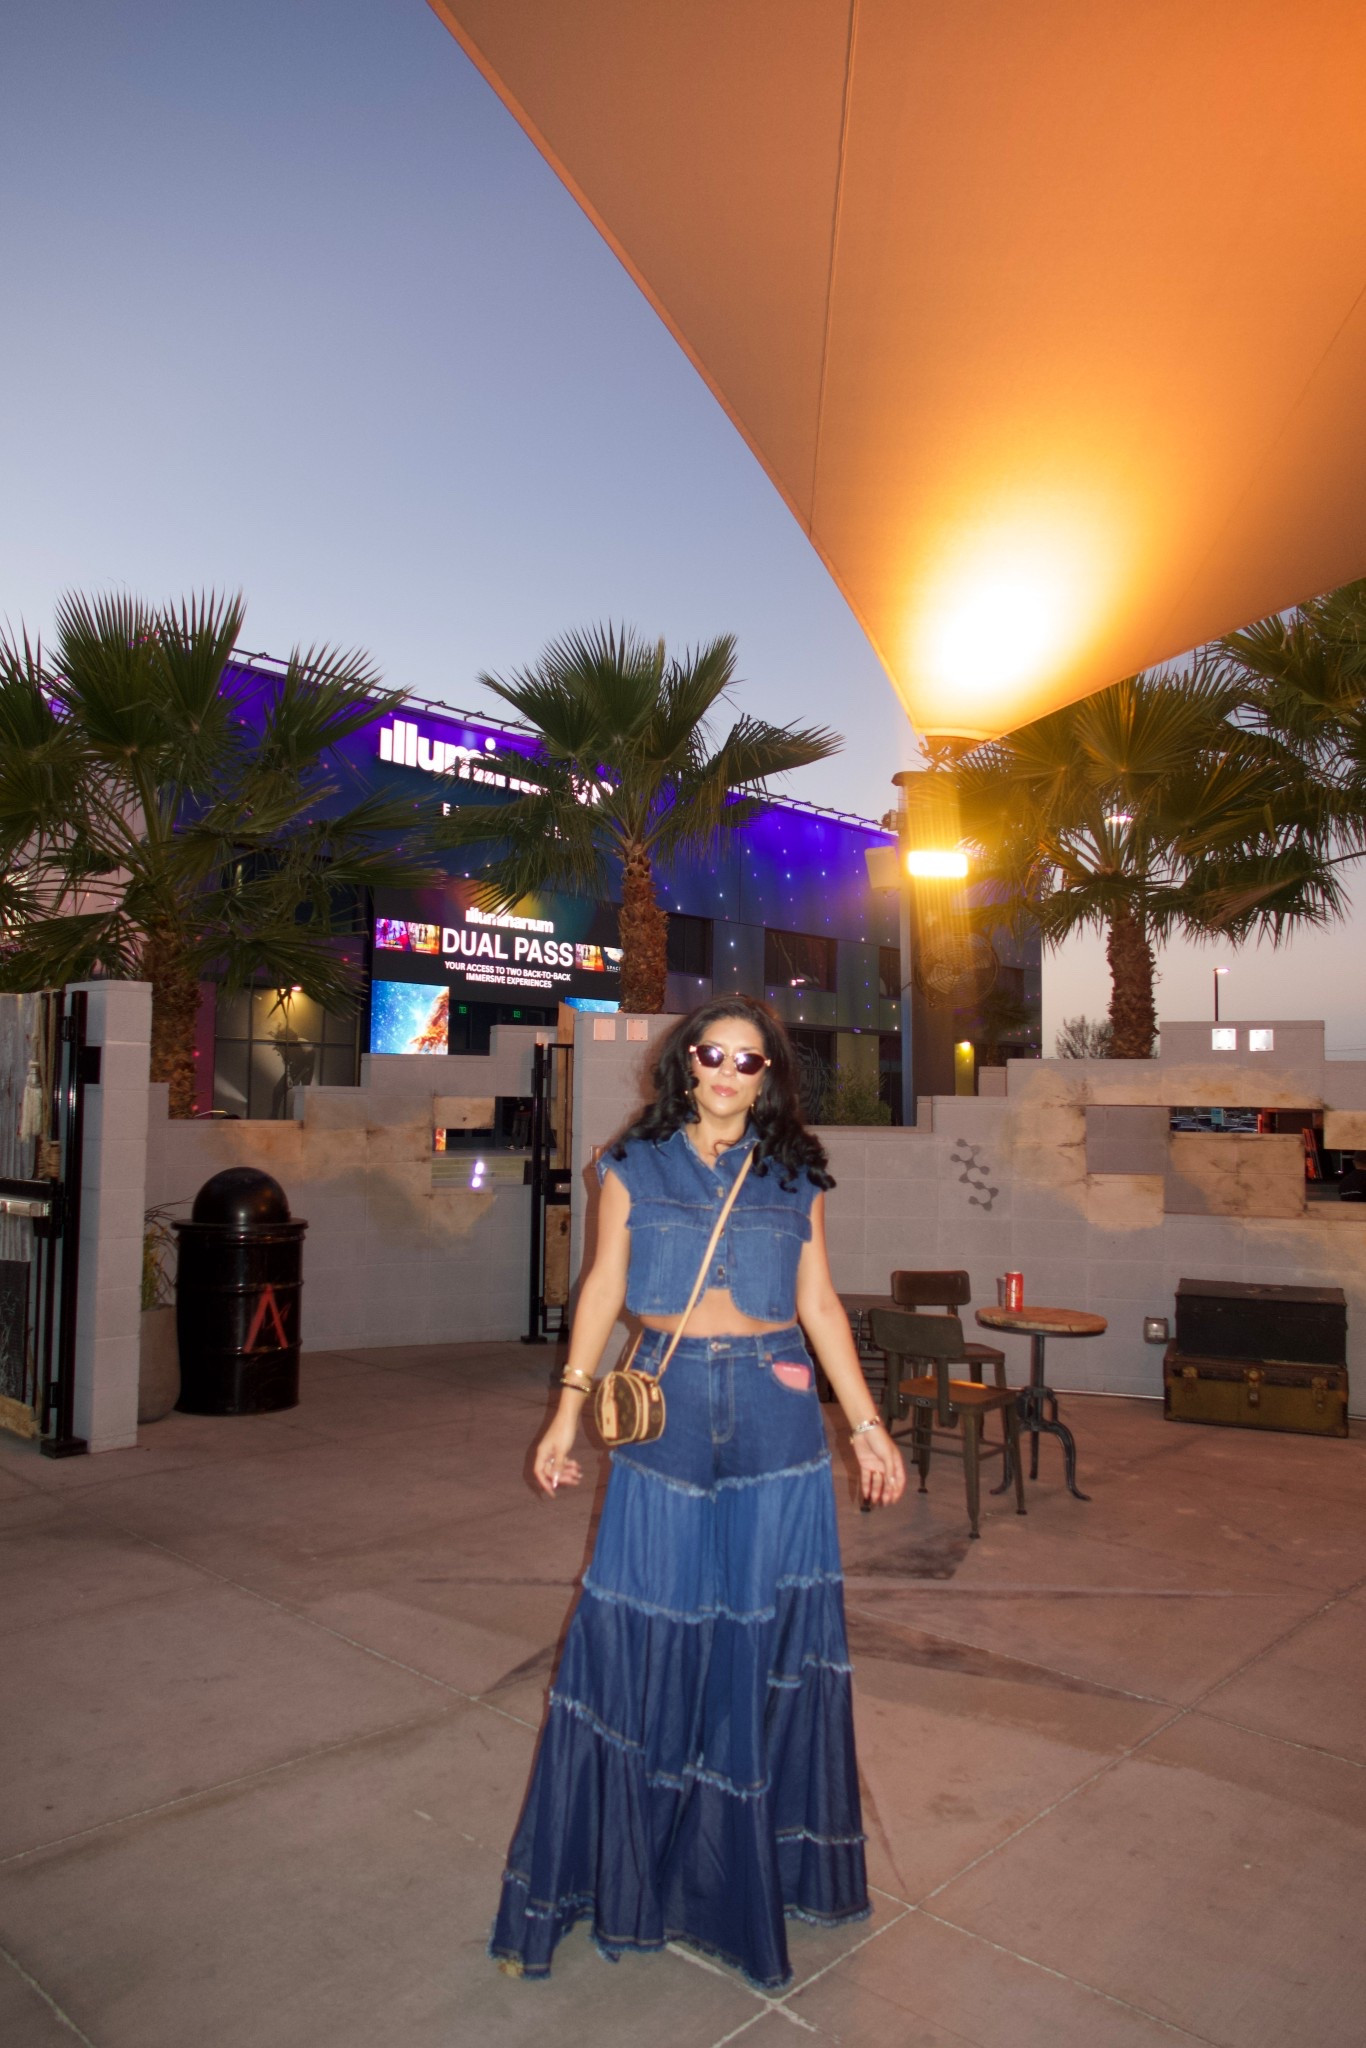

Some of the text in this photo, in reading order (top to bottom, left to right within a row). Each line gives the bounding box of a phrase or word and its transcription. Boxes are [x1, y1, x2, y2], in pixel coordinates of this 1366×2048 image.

[465, 906, 554, 933] illuminarium
[442, 927, 574, 967] DUAL PASS
[445, 961, 571, 982] YOUR ACCESS TO TWO BACK-TO-BACK
[466, 973, 552, 988] IMMERSIVE EXPERIENCES
